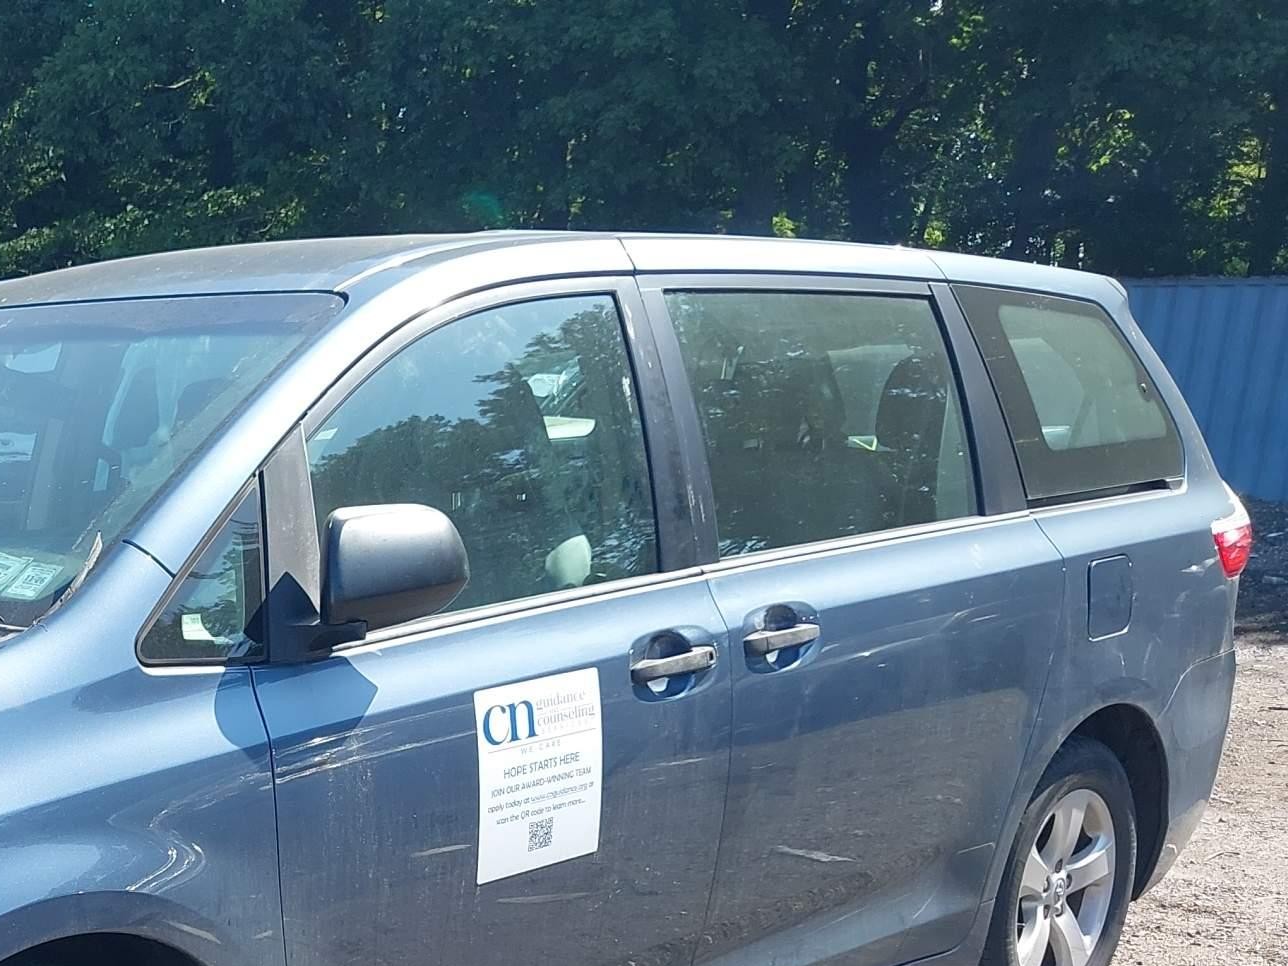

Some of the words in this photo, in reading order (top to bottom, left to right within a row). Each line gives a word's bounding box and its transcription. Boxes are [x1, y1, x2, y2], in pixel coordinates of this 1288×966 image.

[536, 691, 586, 710] guidance
[482, 700, 538, 746] cn
[537, 704, 595, 727] counseling
[503, 764, 528, 779] HOPE
[529, 757, 557, 773] STARTS
[559, 752, 580, 765] HERE
[491, 787, 505, 799] JOIN
[506, 784, 520, 794] OUR
[521, 770, 574, 790] AWARD-WINNING
[575, 766, 592, 777] TEAM
[487, 803, 504, 814] apply
[505, 799, 523, 810] today
[509, 813, 519, 822] the
[520, 809, 530, 820] QR
[530, 808, 544, 817] code
[552, 802, 567, 811] learn
